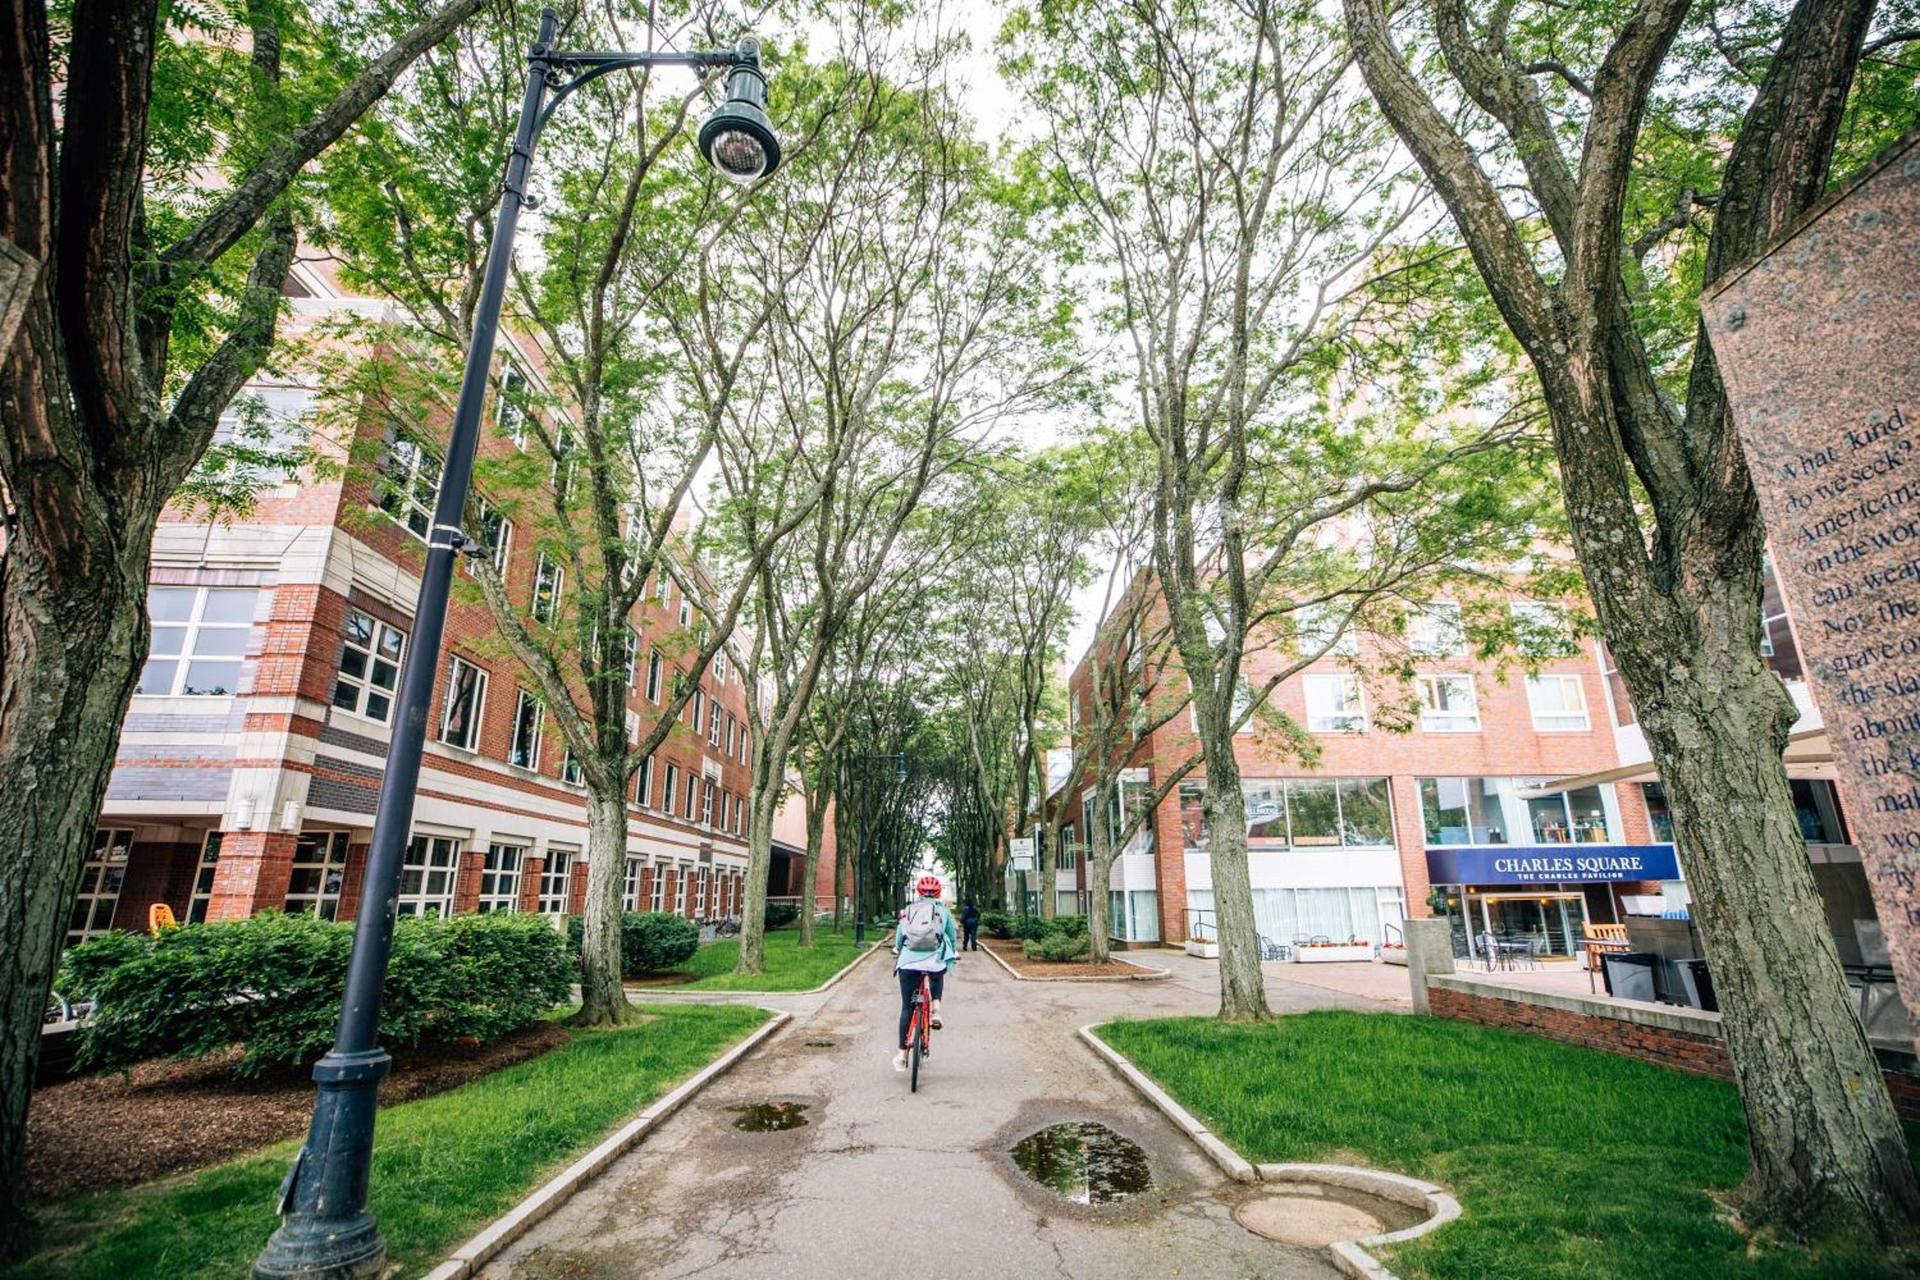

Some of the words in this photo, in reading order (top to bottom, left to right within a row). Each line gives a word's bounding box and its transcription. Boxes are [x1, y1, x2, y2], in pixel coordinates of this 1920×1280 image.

[1846, 408, 1904, 450] kind
[1785, 495, 1812, 514] do
[1816, 476, 1847, 499] we
[1850, 439, 1912, 484] seek?
[1804, 556, 1831, 575] on
[1834, 541, 1868, 564] the
[1813, 585, 1853, 607] can
[1878, 597, 1919, 623] the
[1833, 643, 1894, 677] grave
[1839, 684, 1876, 704] the
[1861, 754, 1900, 776] the
[1494, 858, 1573, 872] CHARLES
[1576, 857, 1643, 872] SQUARE
